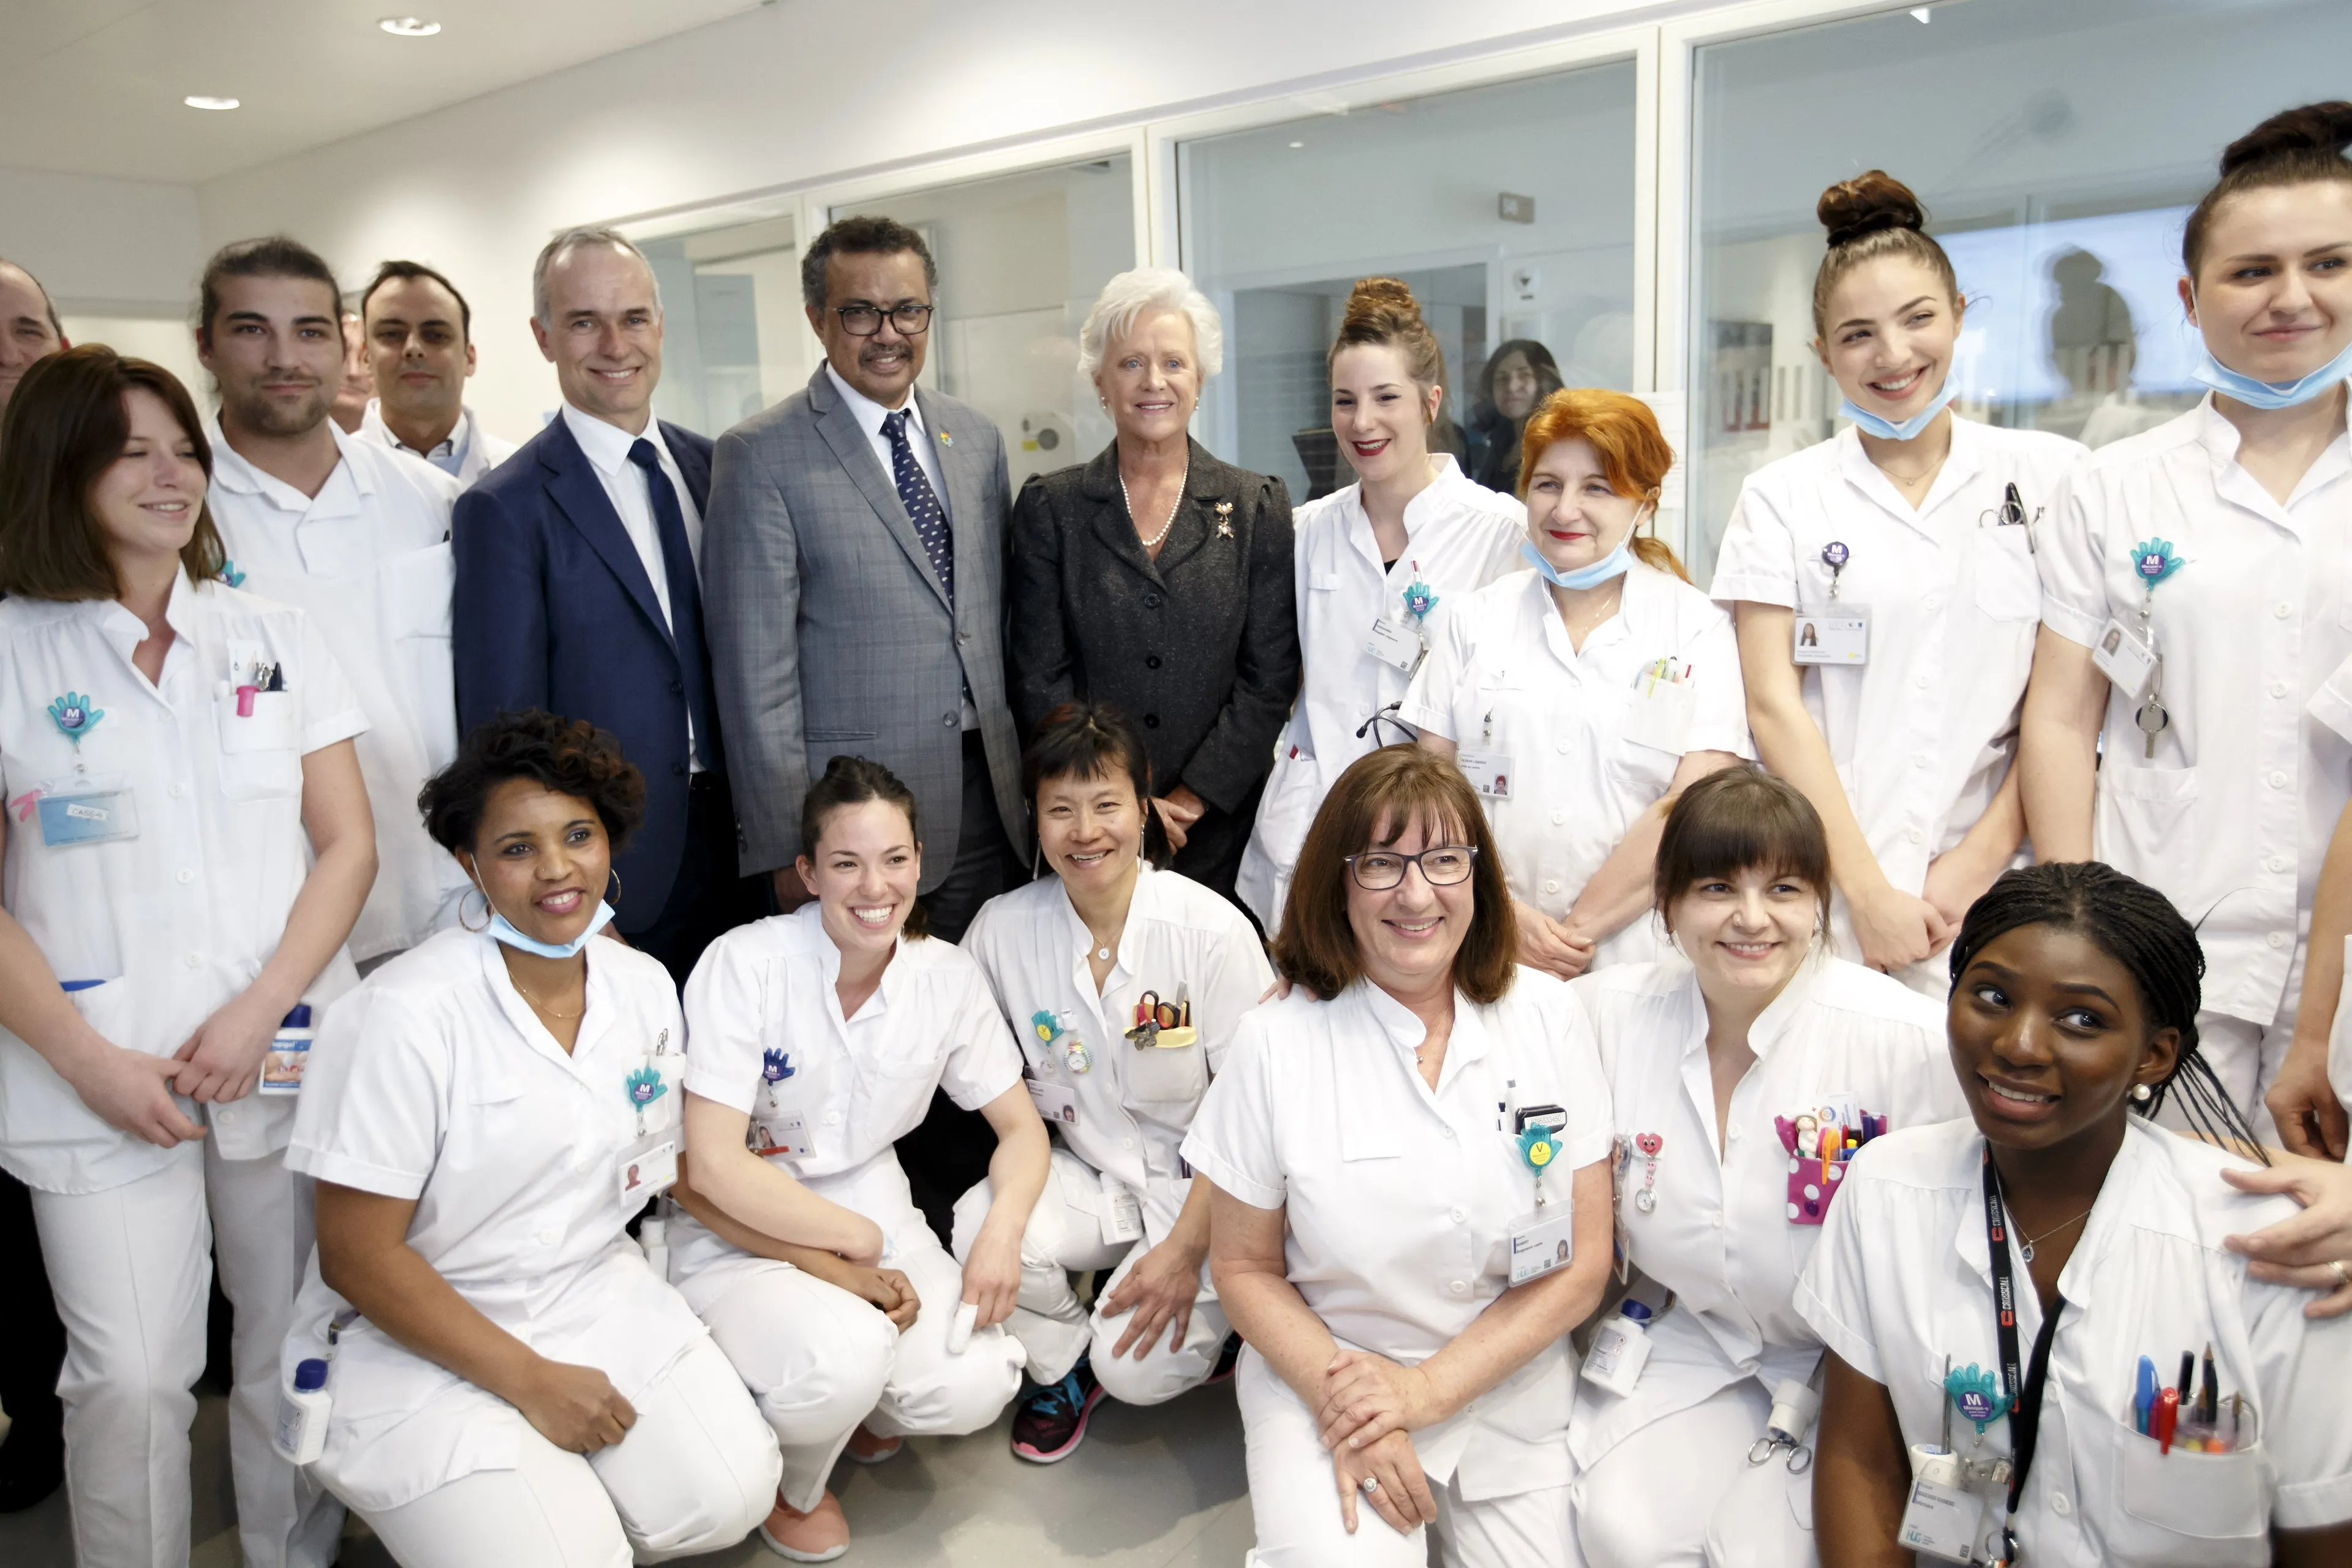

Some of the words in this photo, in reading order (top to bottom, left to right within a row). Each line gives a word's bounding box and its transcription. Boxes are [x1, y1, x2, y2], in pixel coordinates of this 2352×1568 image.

[1831, 545, 1842, 554] M
[2146, 556, 2159, 564] M
[1414, 597, 1423, 605] M
[67, 708, 80, 717] M
[639, 1084, 650, 1093] M
[1536, 1143, 1544, 1152] V
[1965, 1393, 1981, 1406] M
